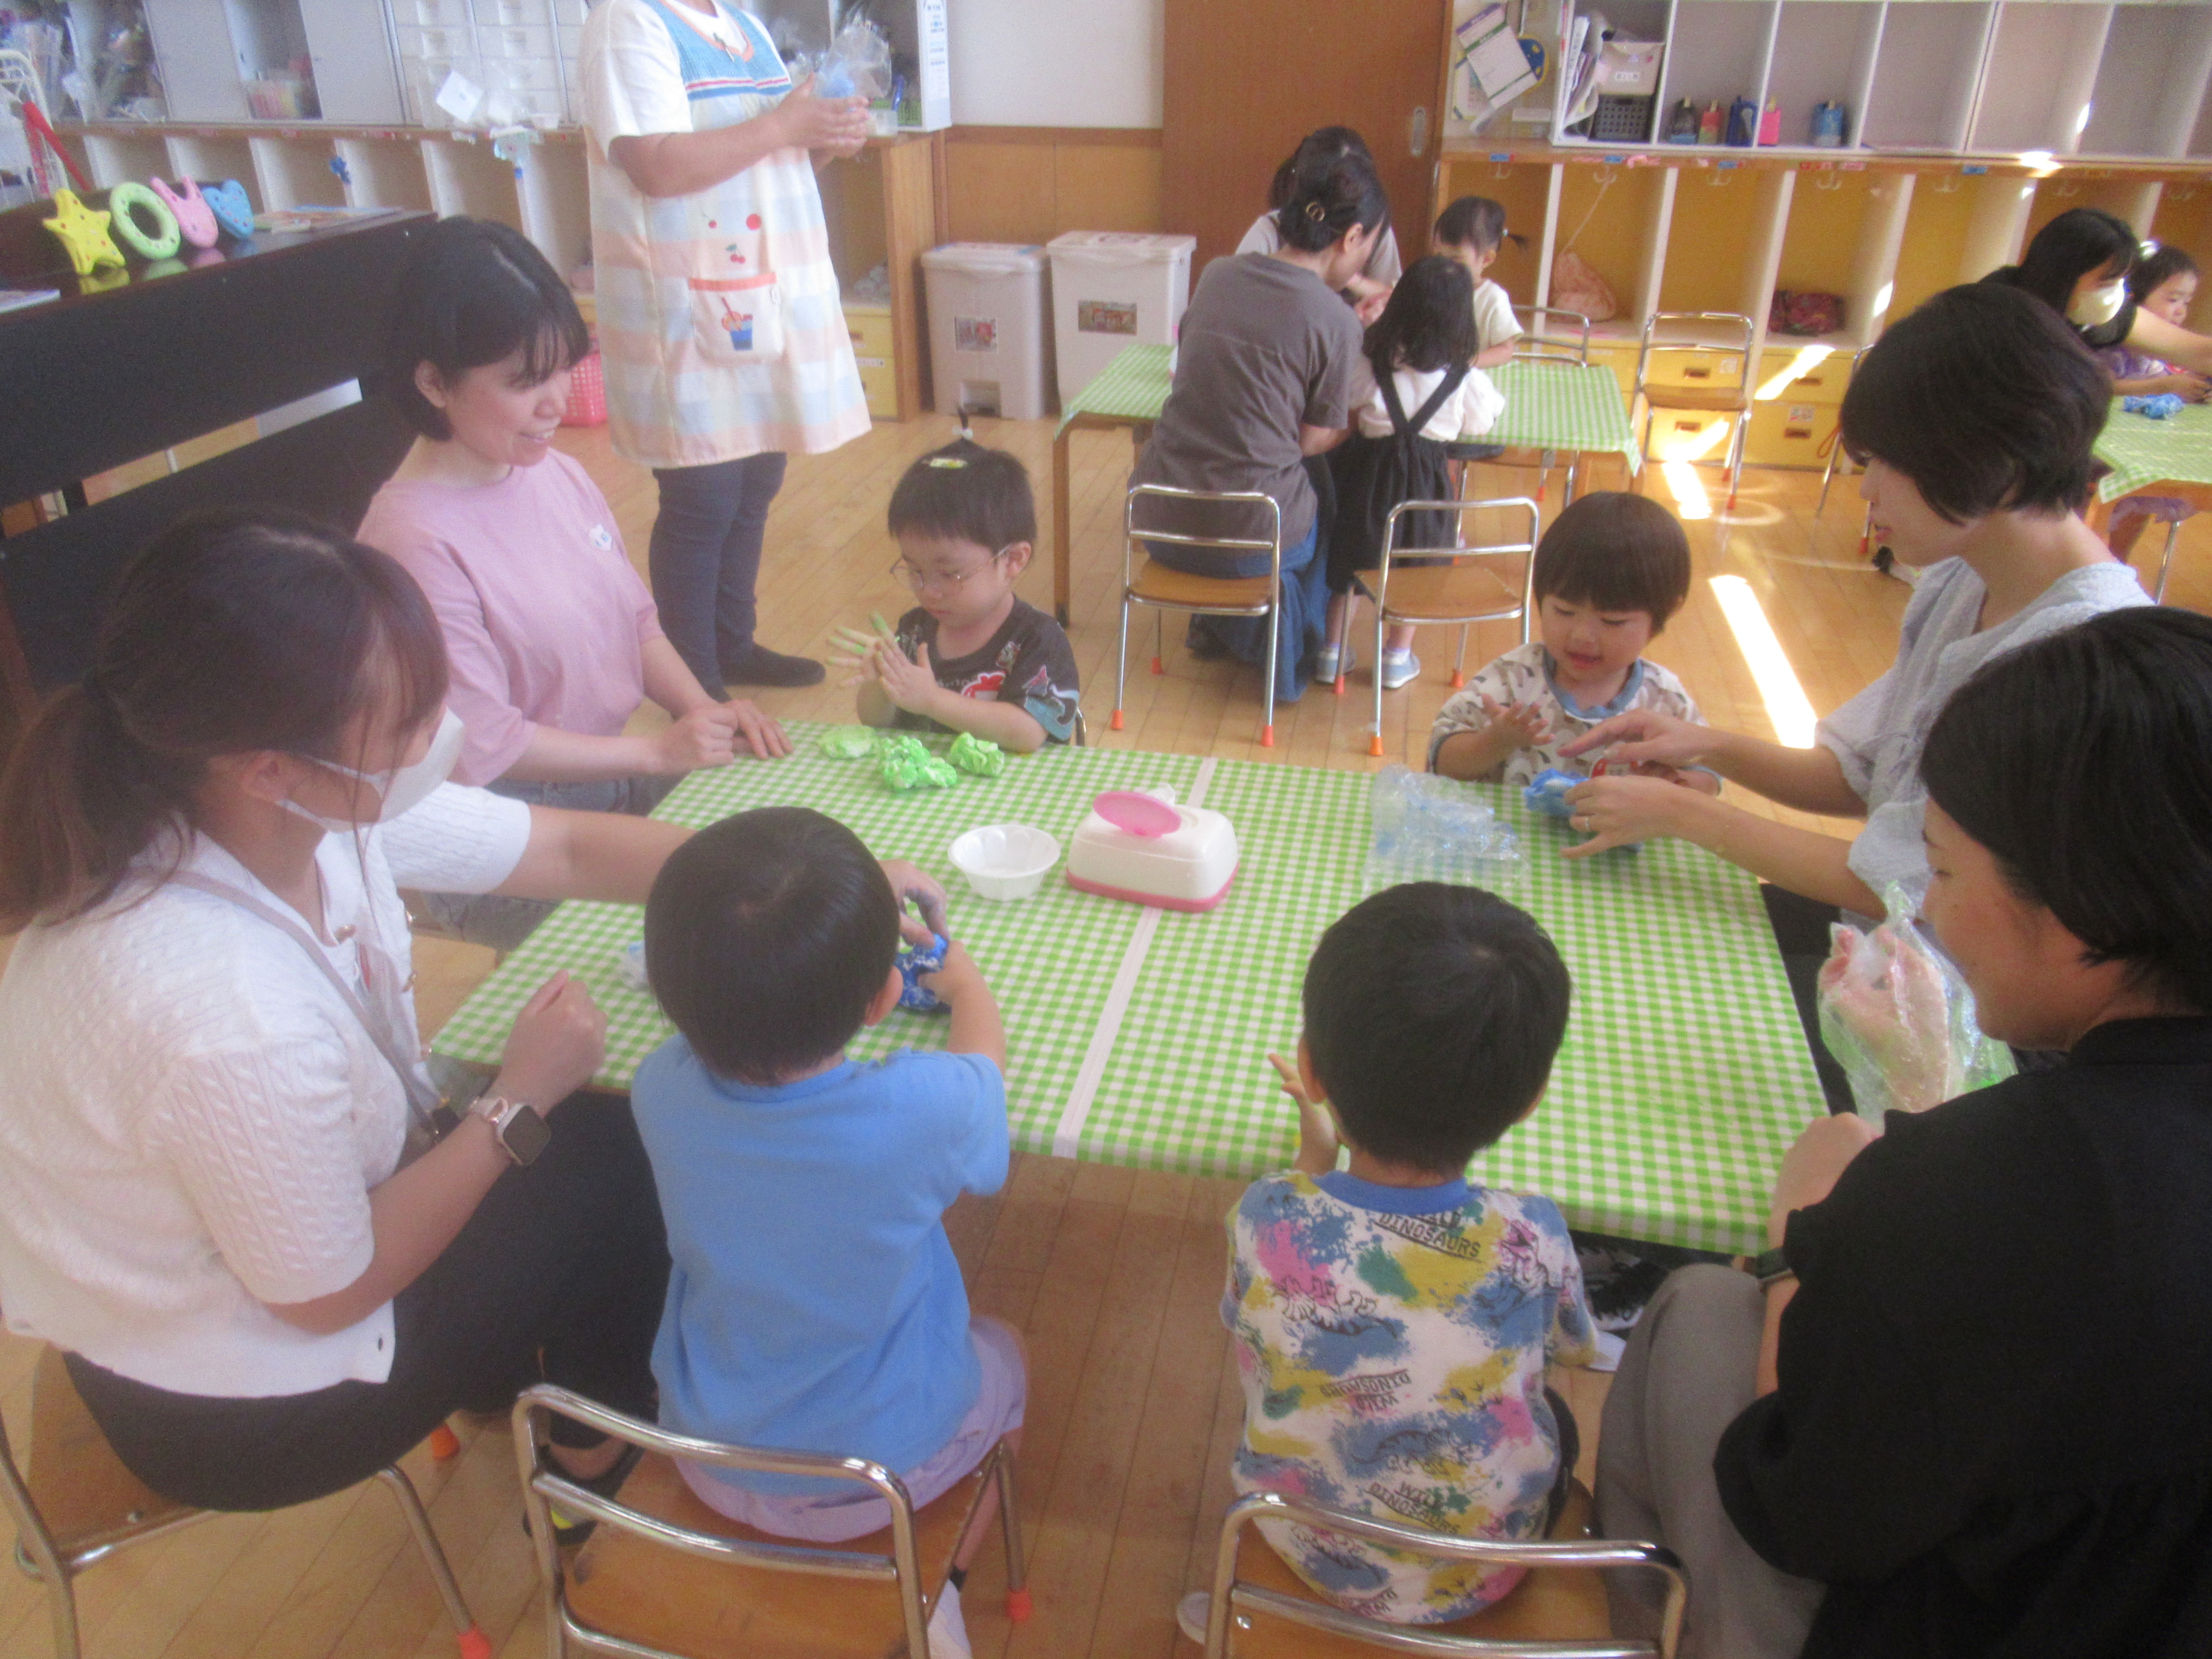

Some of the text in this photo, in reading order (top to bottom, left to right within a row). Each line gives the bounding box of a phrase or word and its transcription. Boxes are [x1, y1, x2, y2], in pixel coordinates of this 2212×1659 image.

[1379, 1213, 1481, 1257] DINOSAURS
[1320, 1371, 1412, 1398] DINOSAURS
[1369, 1482, 1460, 1533] DINOSAURS
